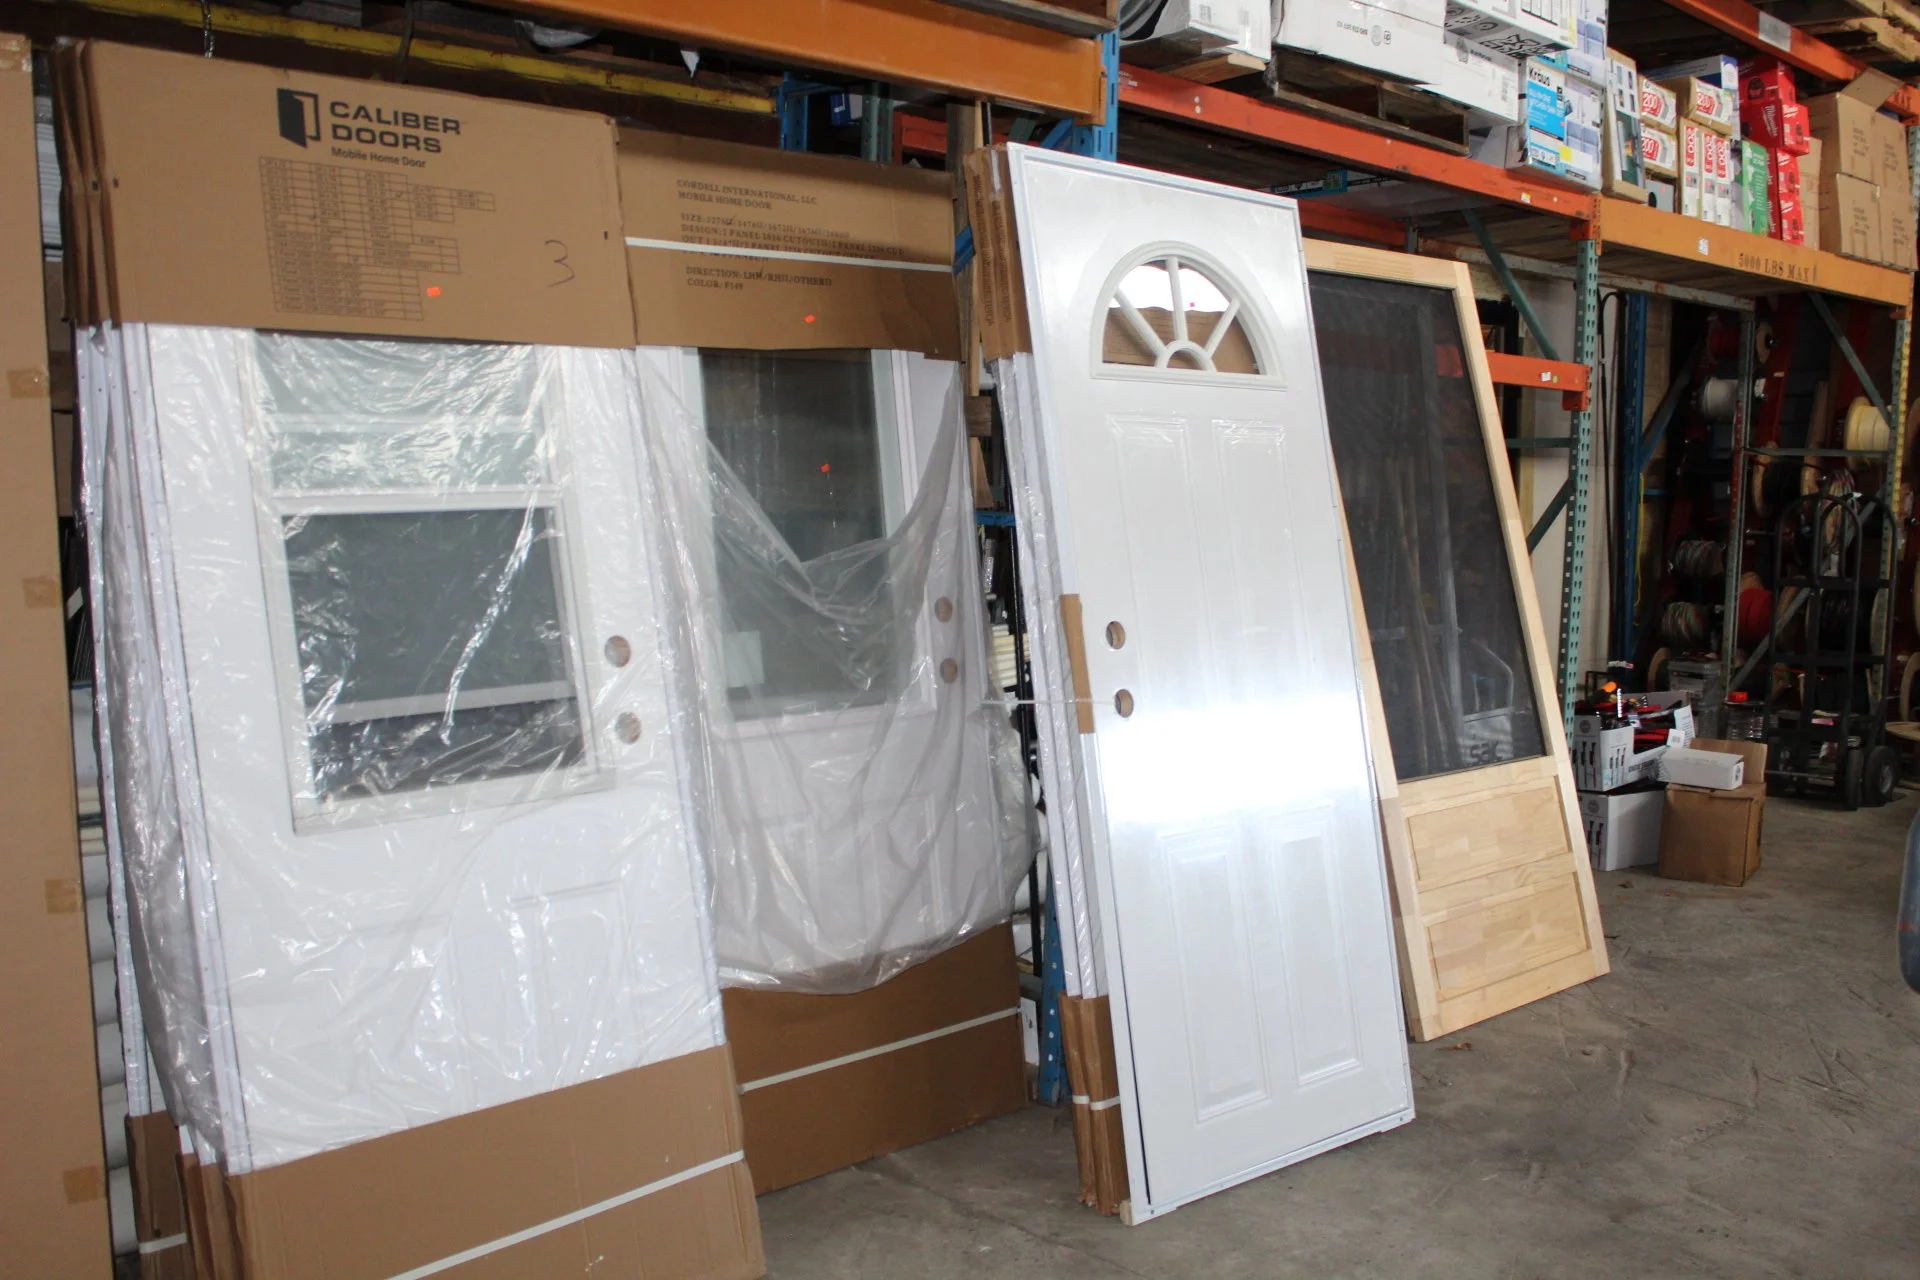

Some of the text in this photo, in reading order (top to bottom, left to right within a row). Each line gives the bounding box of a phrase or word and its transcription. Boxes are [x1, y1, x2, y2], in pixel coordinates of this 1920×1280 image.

[329, 101, 462, 135] CALIBER
[331, 123, 442, 154] DOORS
[331, 147, 427, 168] Mobile Home Door
[677, 179, 721, 193] CORDELL
[801, 195, 818, 205] LLC
[678, 190, 773, 210] MOBILE HOME DOOR
[545, 239, 575, 288] 3
[685, 266, 741, 279] DIRECTION:
[1738, 252, 1810, 283] 5000 LBS MAX
